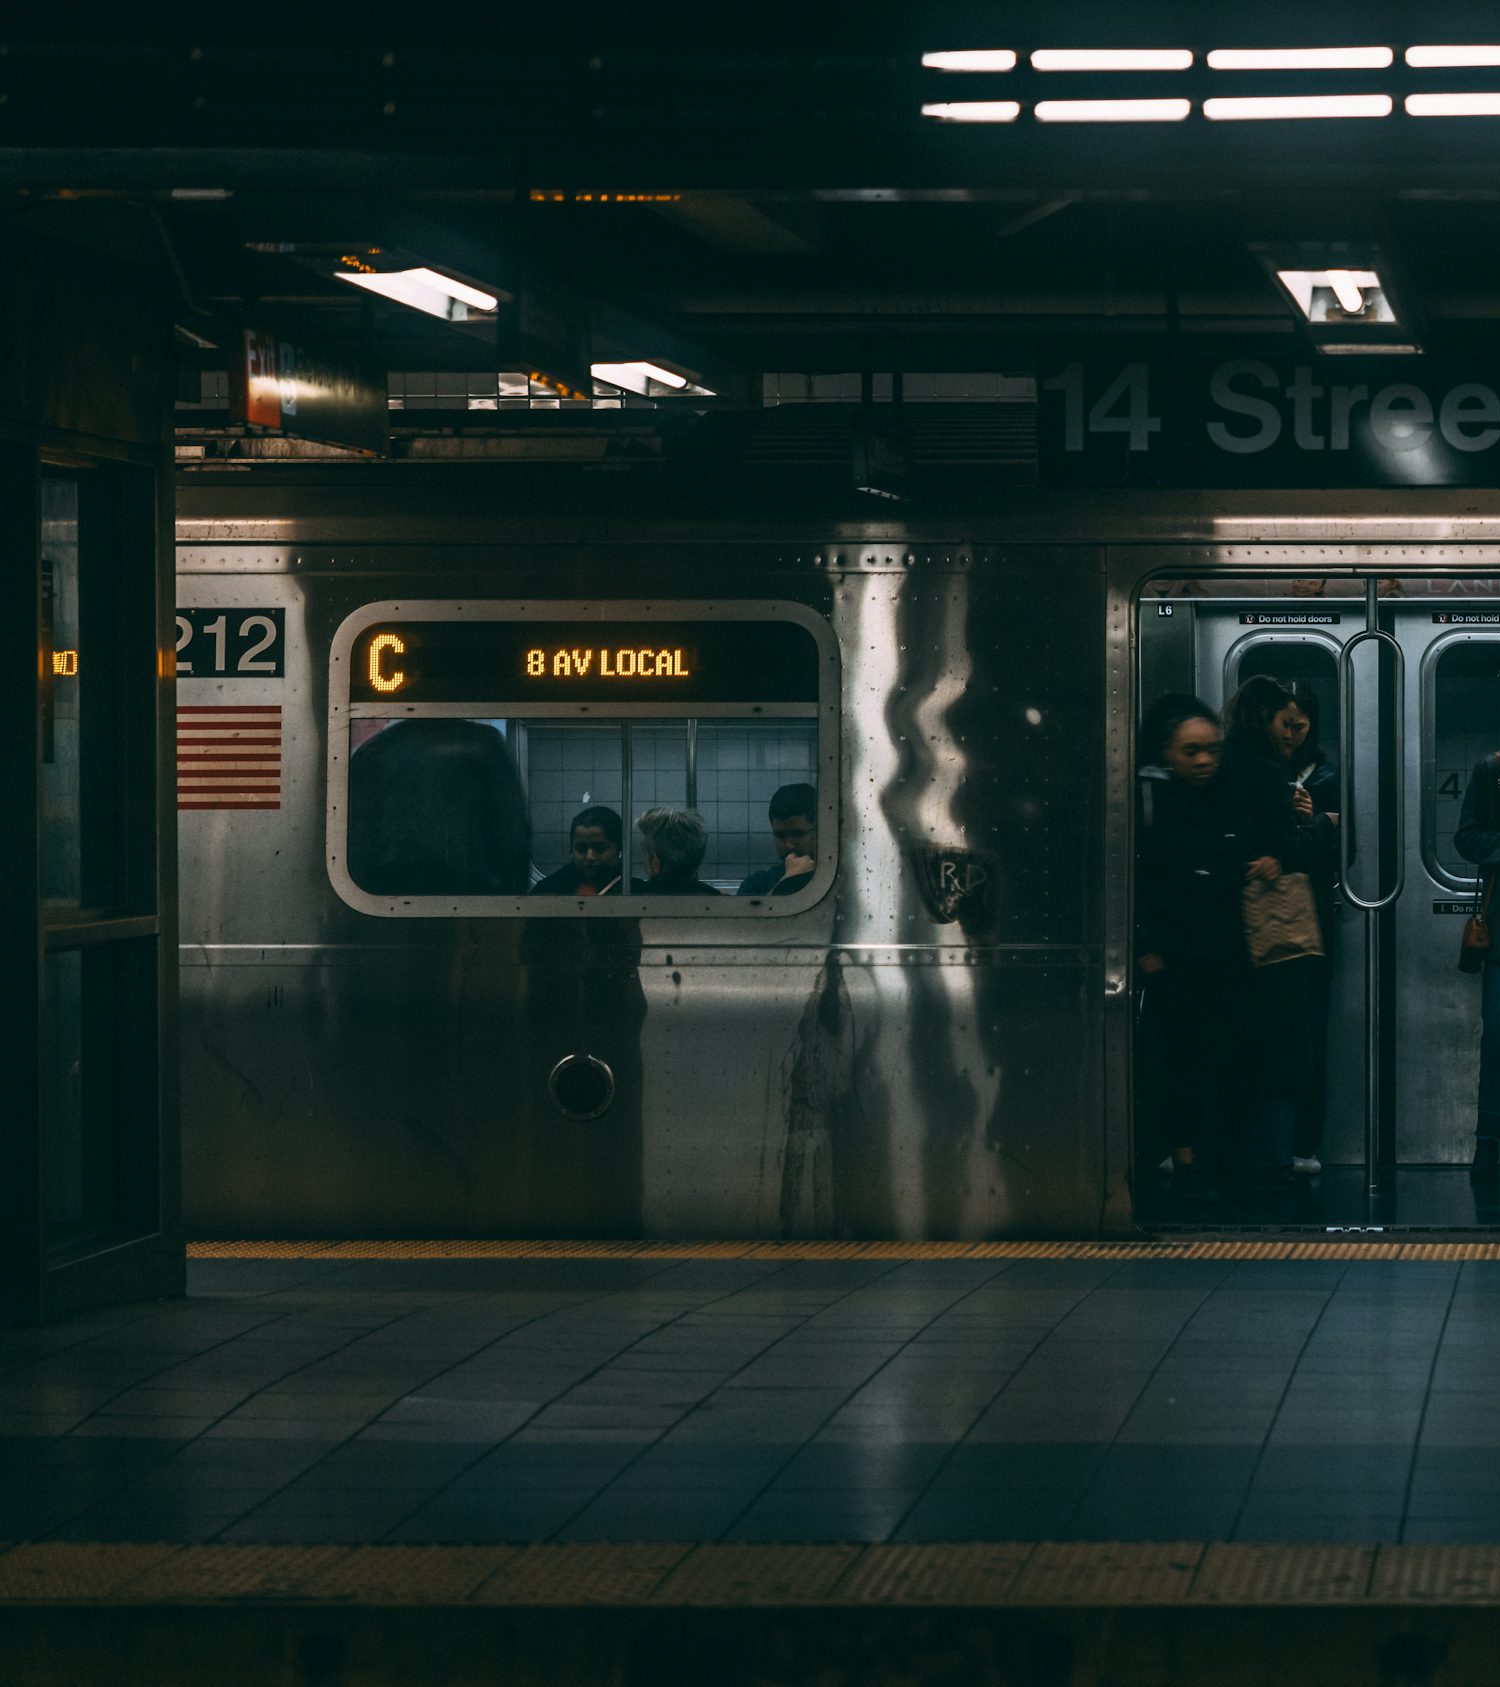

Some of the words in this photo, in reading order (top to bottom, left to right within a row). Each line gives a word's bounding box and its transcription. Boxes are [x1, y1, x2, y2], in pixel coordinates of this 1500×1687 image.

[1043, 362, 1162, 452] 14
[1158, 606, 1173, 616] L6
[1259, 615, 1271, 623] Do
[1272, 615, 1286, 623] not
[1288, 615, 1307, 623] hold
[1308, 615, 1333, 623] doors
[1451, 614, 1464, 623] Do
[1465, 614, 1480, 623] not
[1481, 614, 1500, 623] hold
[369, 633, 404, 692] C
[527, 649, 545, 676] 8
[553, 649, 592, 676] AV
[600, 649, 689, 676] LOCAL
[1438, 772, 1462, 799] 4
[1452, 904, 1464, 913] Do
